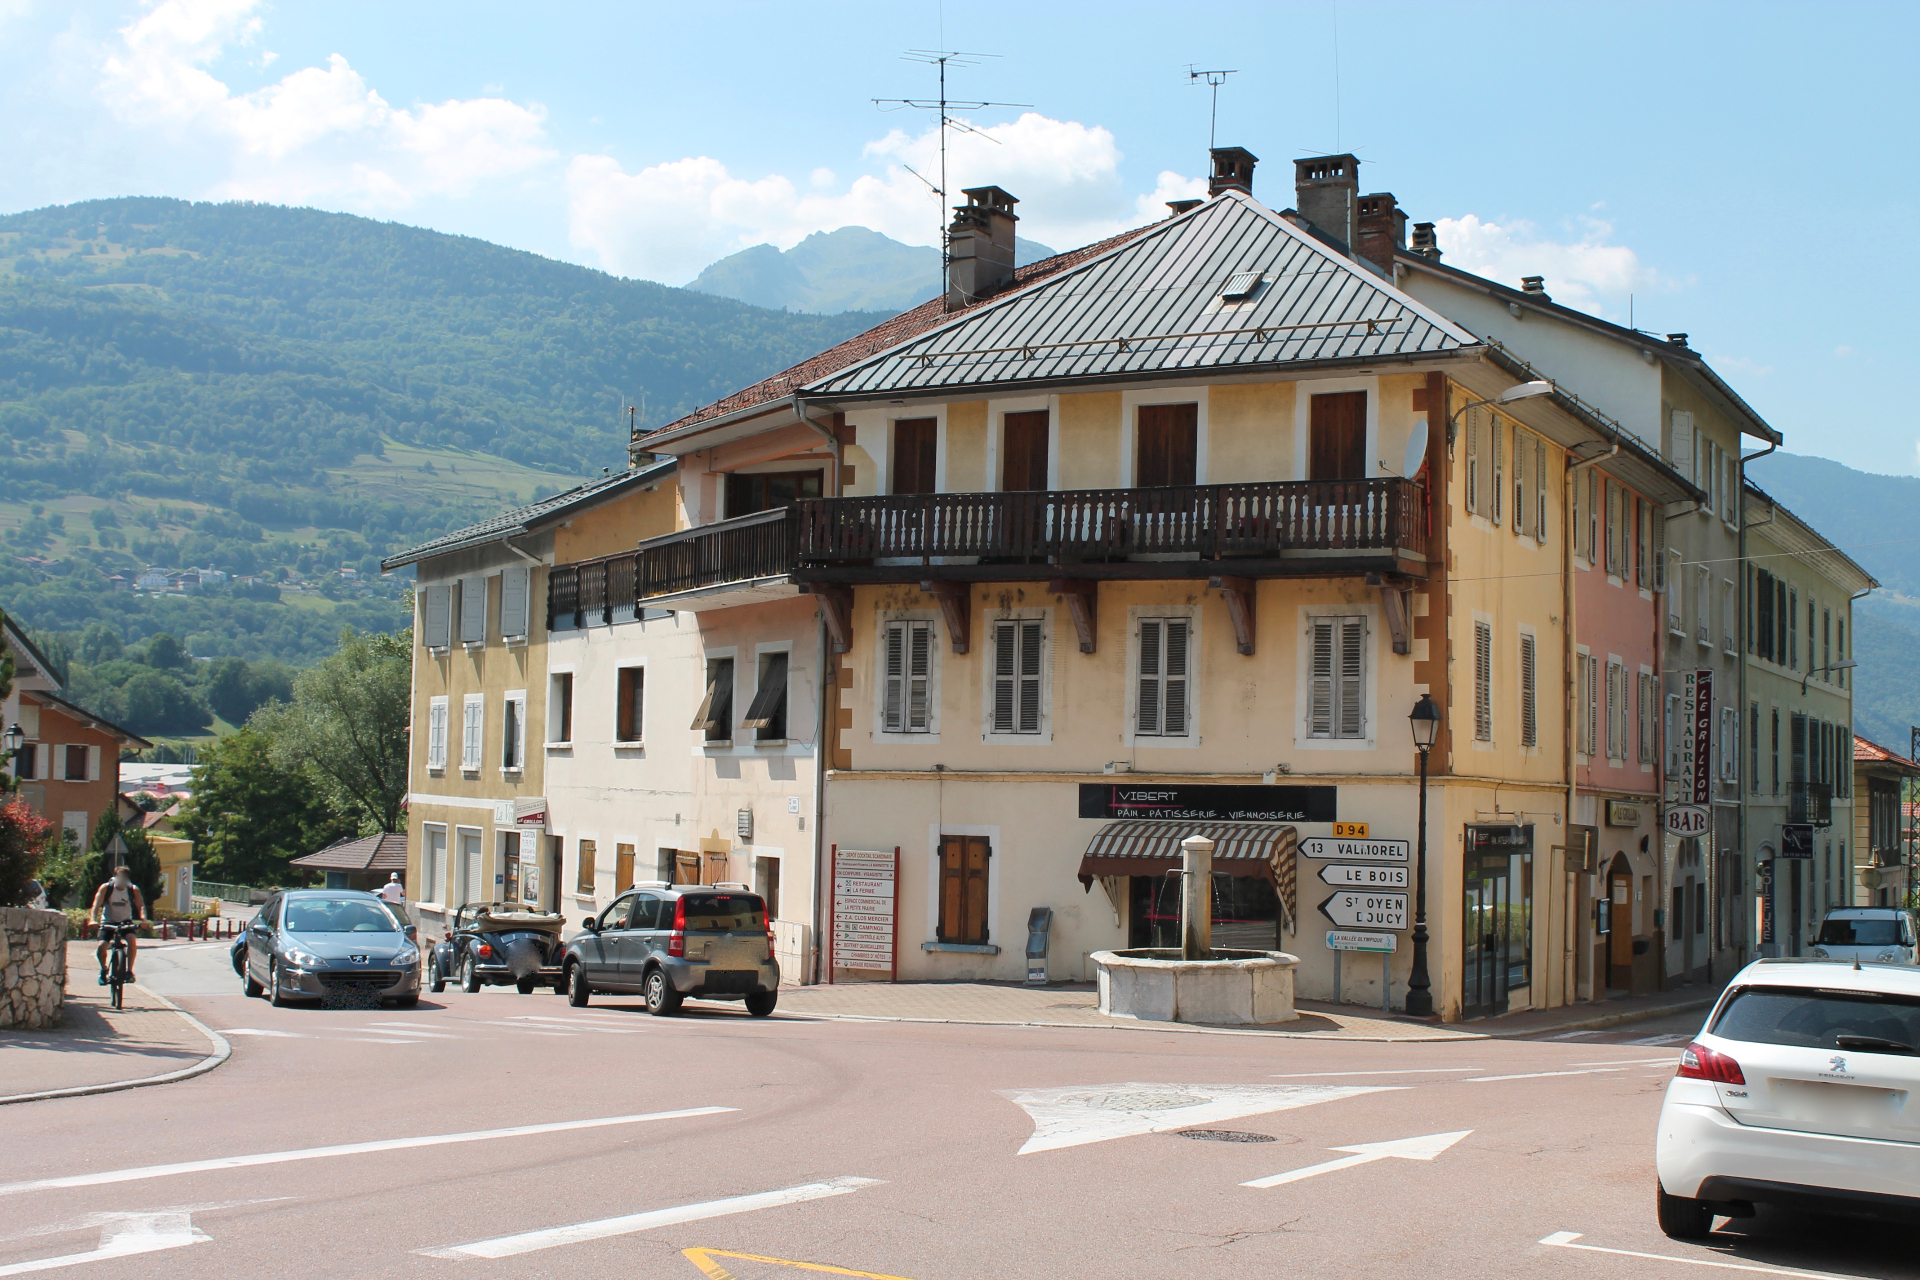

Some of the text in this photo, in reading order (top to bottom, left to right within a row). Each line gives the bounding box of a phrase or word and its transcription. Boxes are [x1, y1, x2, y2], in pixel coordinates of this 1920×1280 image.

[1682, 674, 1695, 802] RESTAURANT
[1697, 690, 1708, 800] LE GRILLON
[1118, 791, 1178, 800] VIBERT
[1117, 808, 1138, 817] PAIN
[1149, 808, 1217, 818] PATISSERIE
[1228, 810, 1306, 820] VIENNOISERIE
[1669, 811, 1704, 831] BAR
[1336, 825, 1365, 835] D 94
[1311, 843, 1403, 856] 13 VALMOREL
[1347, 870, 1403, 882] LE BOIS
[1367, 898, 1402, 910] OYEN
[1763, 866, 1772, 940] COIFFURE
